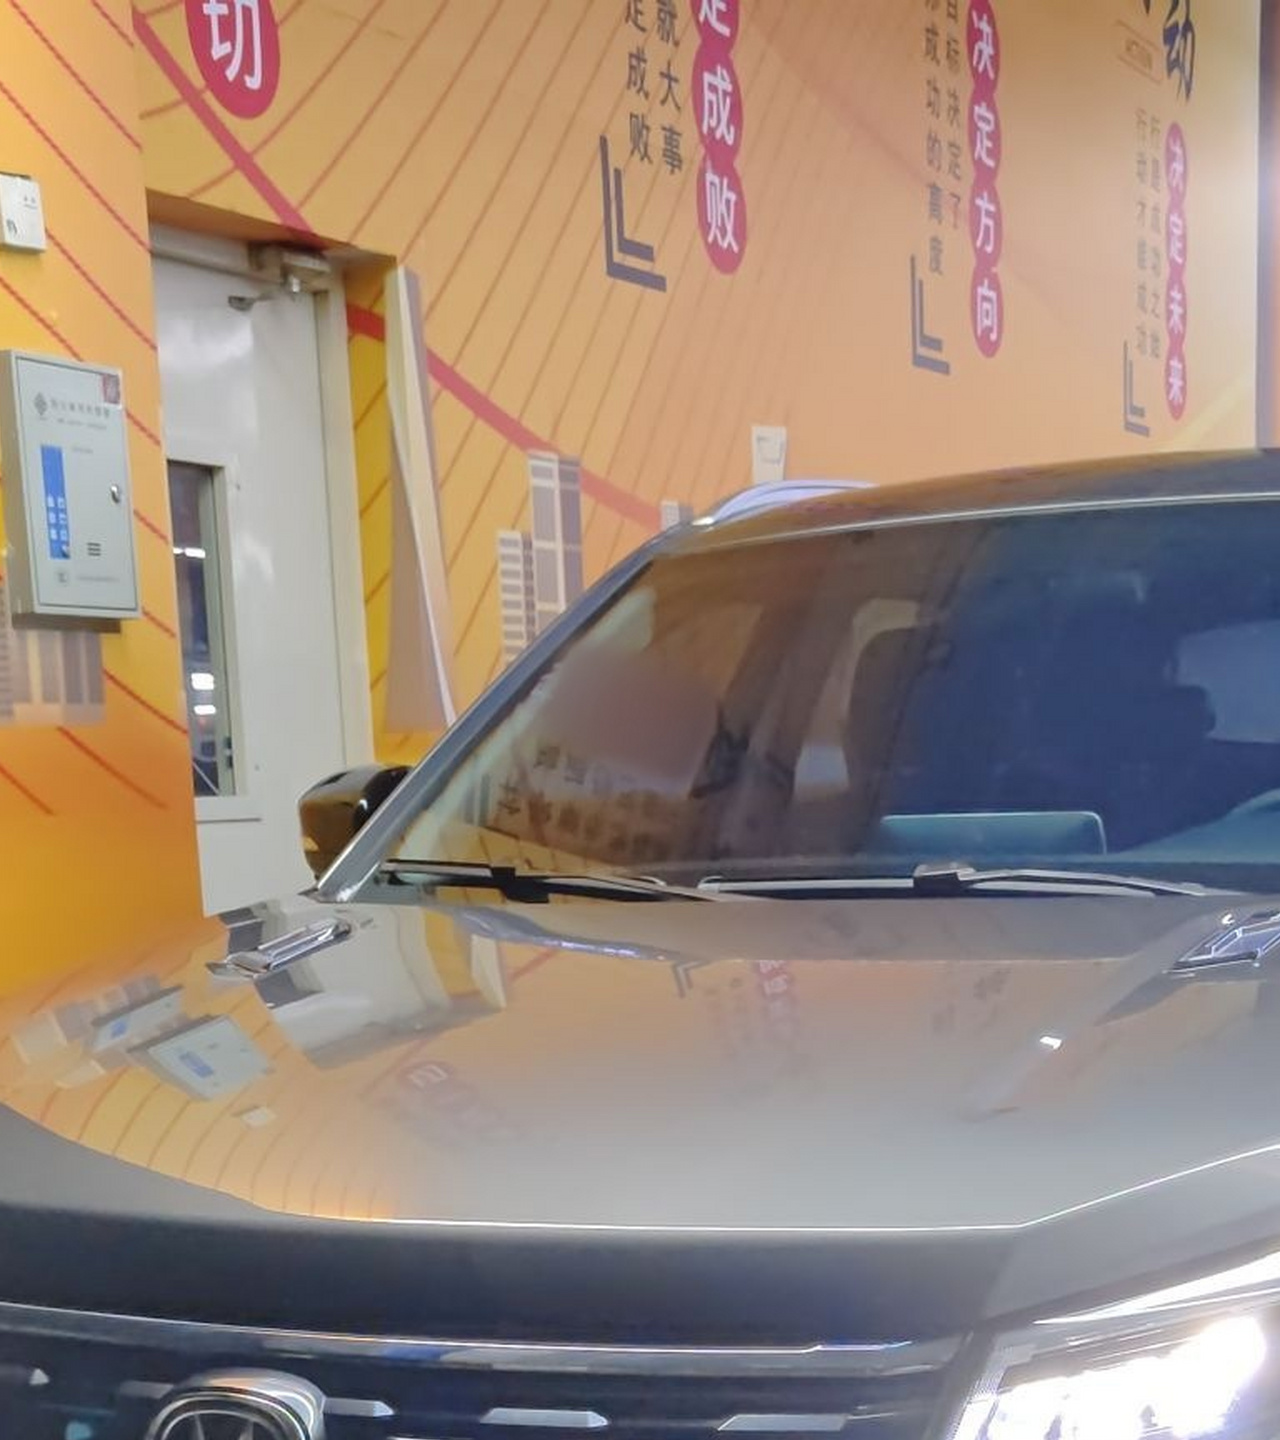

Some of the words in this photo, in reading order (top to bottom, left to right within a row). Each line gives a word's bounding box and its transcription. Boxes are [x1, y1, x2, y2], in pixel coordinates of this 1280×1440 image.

[972, 10, 997, 342] 决定方向
[1168, 135, 1184, 404] 决定未来
